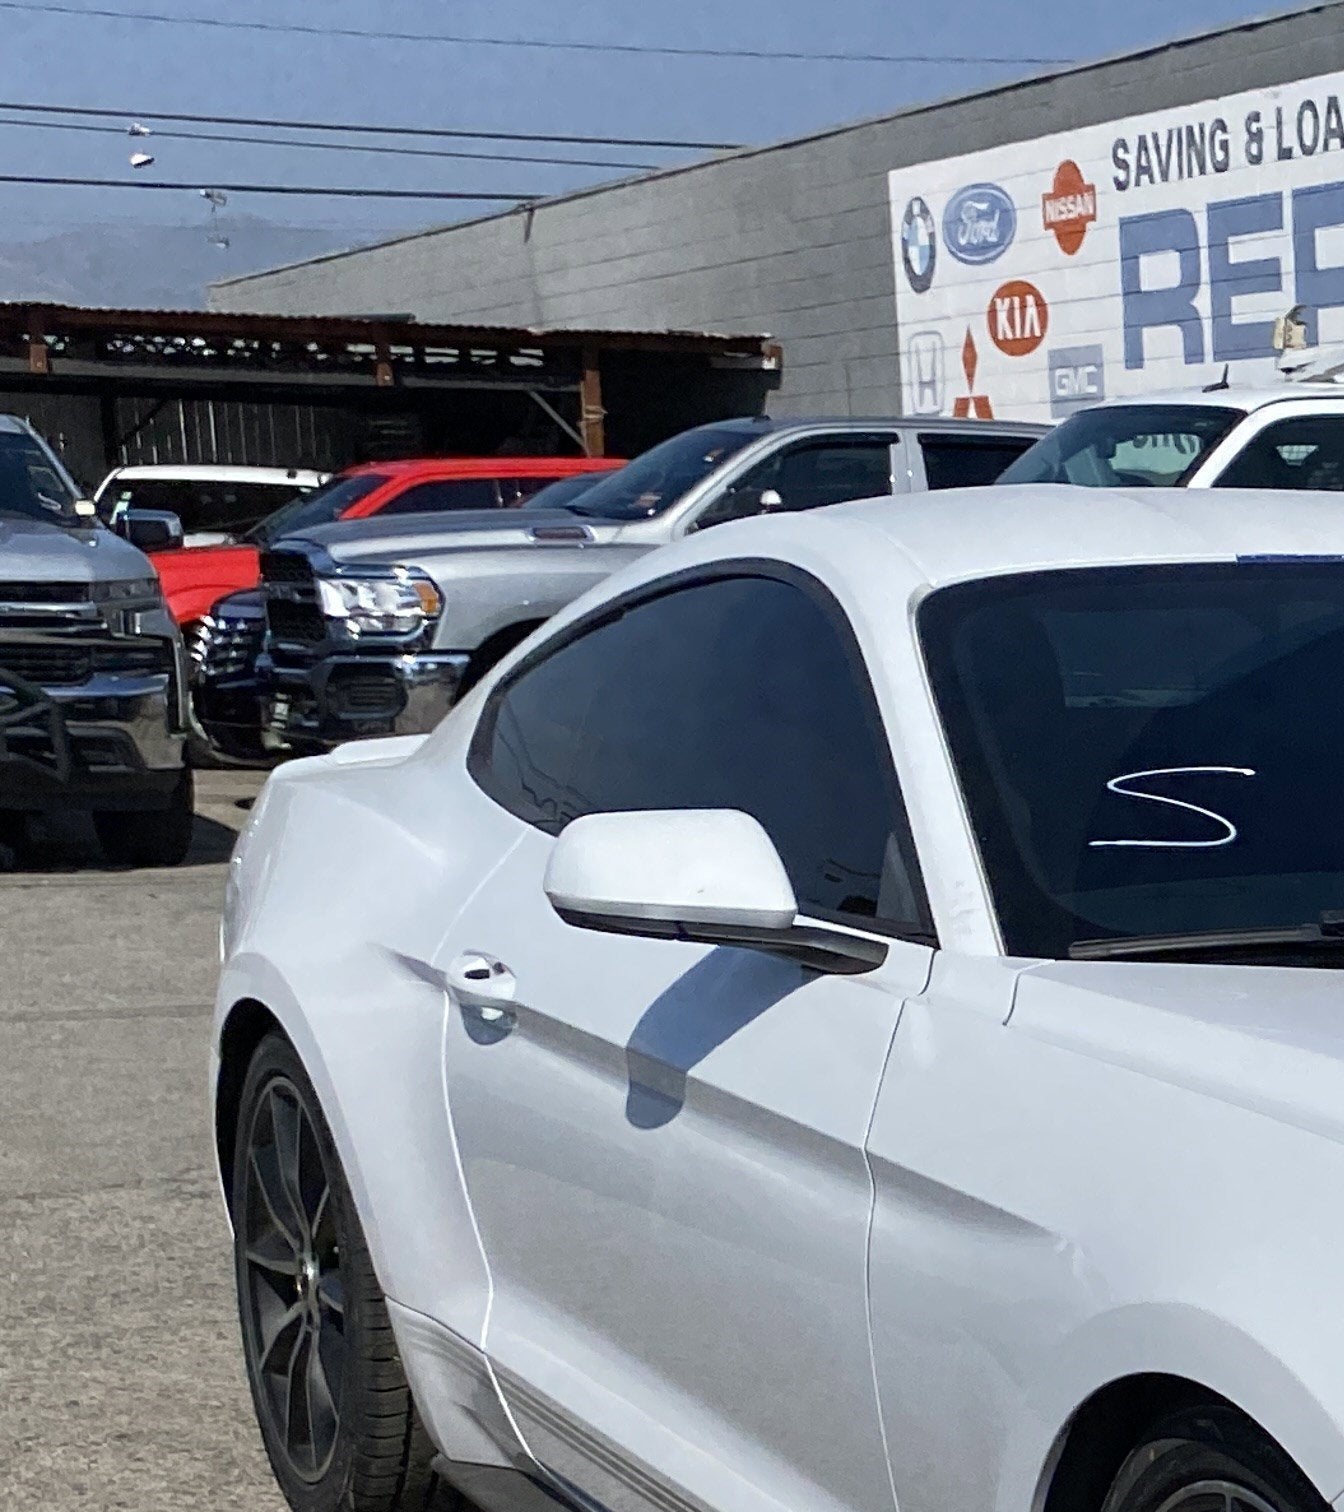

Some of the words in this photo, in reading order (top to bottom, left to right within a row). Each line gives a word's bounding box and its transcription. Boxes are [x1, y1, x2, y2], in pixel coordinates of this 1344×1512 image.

[1111, 119, 1230, 191] SAVING
[1245, 111, 1264, 164] &
[957, 200, 1000, 246] Ford
[1045, 191, 1094, 221] NISSAN
[994, 294, 1042, 341] KIA
[1054, 364, 1099, 397] GMC
